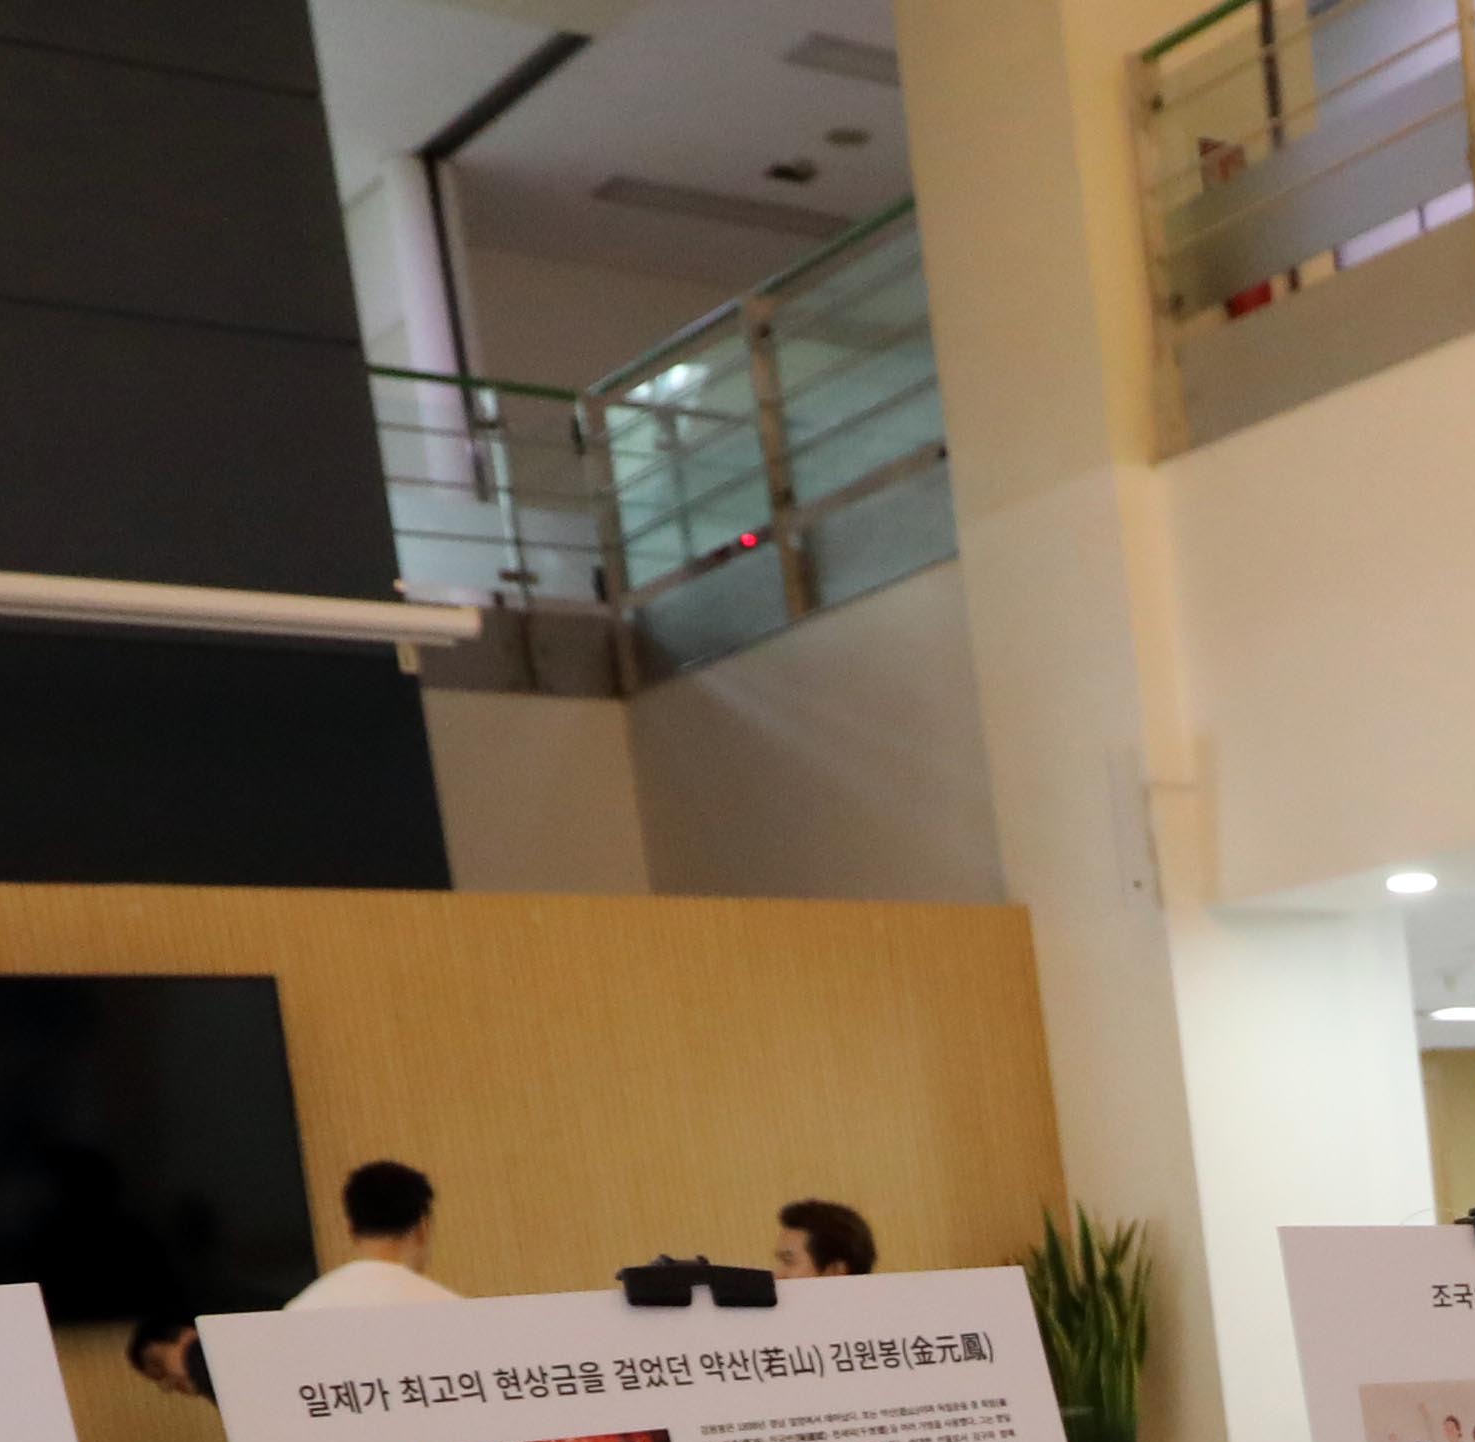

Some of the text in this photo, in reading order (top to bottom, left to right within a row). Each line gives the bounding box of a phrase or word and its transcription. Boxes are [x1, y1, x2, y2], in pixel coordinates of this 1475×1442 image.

[298, 1378, 390, 1418] 일제가
[398, 1370, 487, 1408] 최고의
[492, 1361, 606, 1401] 현상금을
[613, 1353, 694, 1391] 걸었던
[699, 1344, 824, 1383] 약산(若山)
